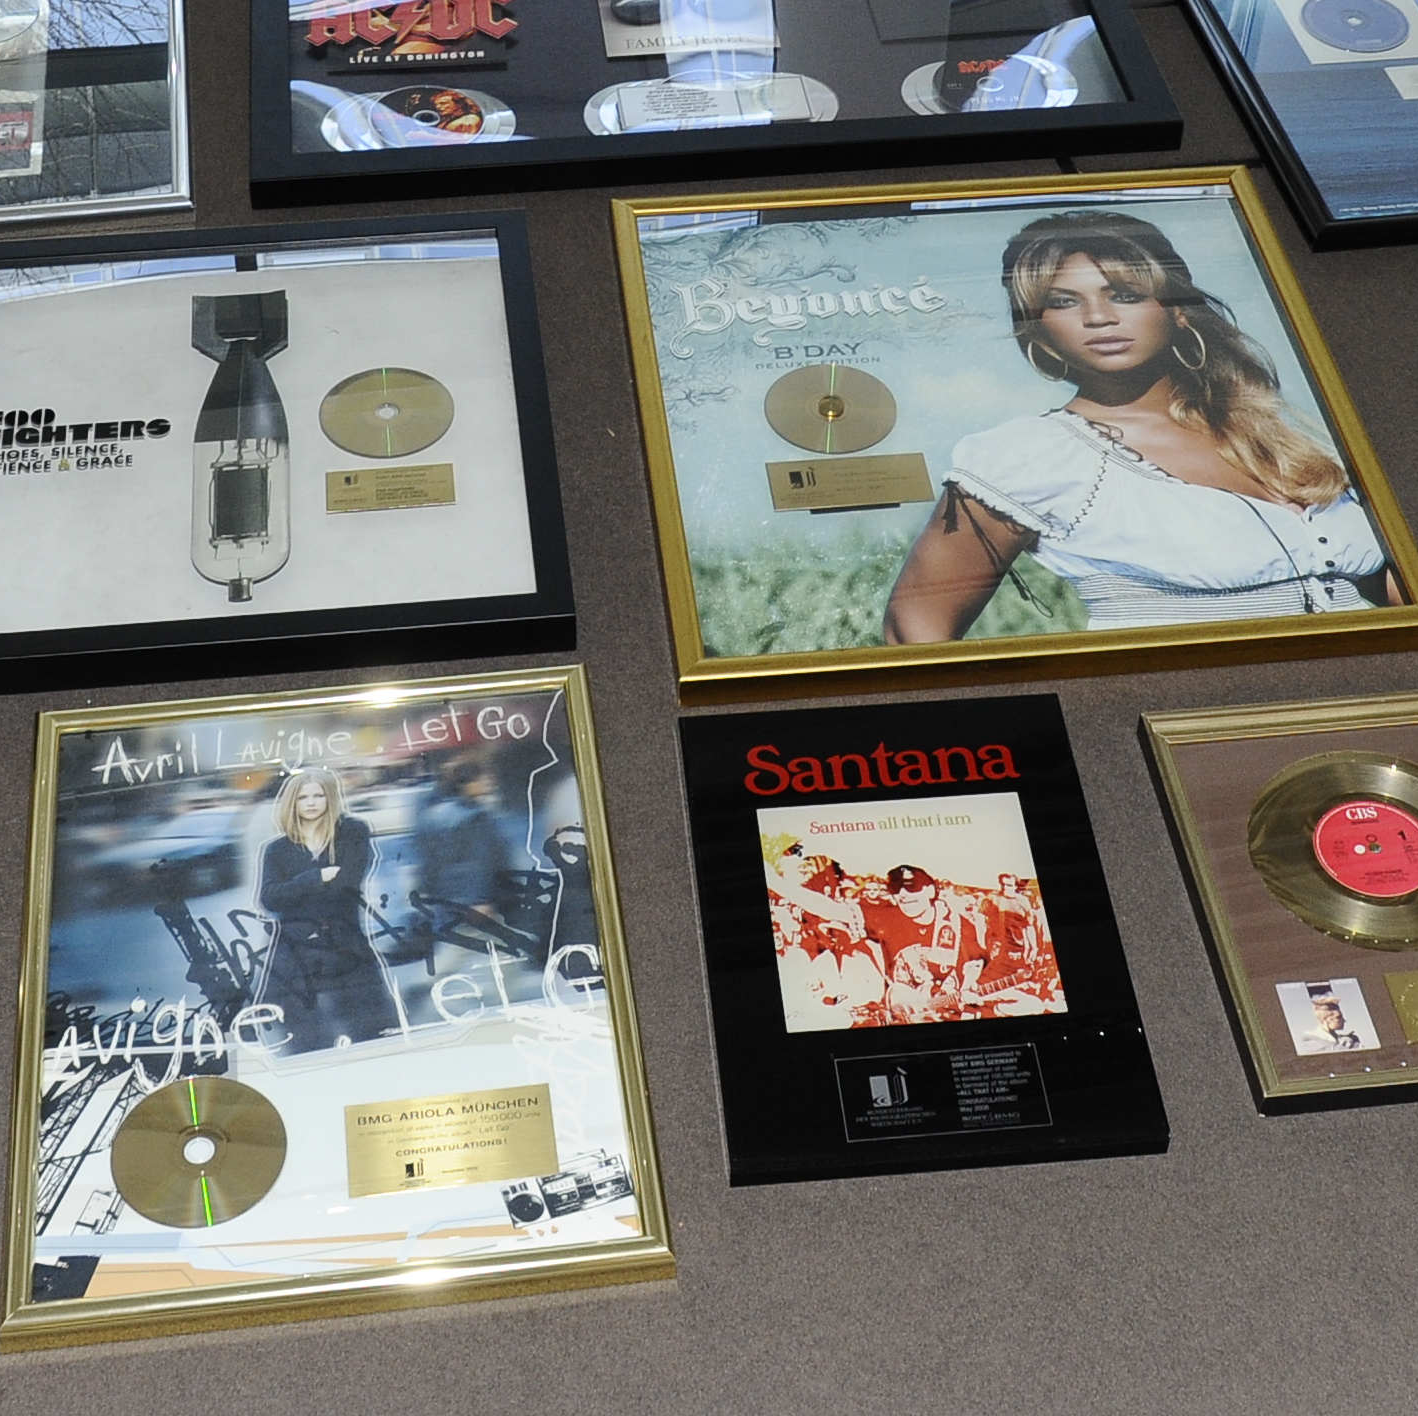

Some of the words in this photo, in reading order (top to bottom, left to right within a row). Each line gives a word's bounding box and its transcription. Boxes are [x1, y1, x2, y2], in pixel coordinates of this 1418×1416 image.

[348, 53, 379, 65] LIVE
[385, 52, 403, 63] AT
[669, 273, 949, 361] Beyoncé
[773, 340, 864, 361] B'DAY
[755, 358, 826, 371] DELUXE
[829, 355, 882, 368] EDITION
[50, 442, 125, 461] SILENCE,
[75, 453, 134, 470] GRACE
[477, 705, 531, 741] Go
[90, 729, 200, 786] Avril
[743, 740, 1021, 796] Santana
[809, 817, 876, 835] Santana
[877, 818, 899, 831] all
[901, 815, 935, 830] that
[943, 813, 973, 827] am
[1345, 805, 1379, 822] CBS
[356, 1114, 393, 1126] BMG
[399, 1106, 456, 1122] ARIOLA
[461, 1096, 539, 1115] MÜNCHEN
[395, 1137, 508, 1157] CONGRATULATIONS!
